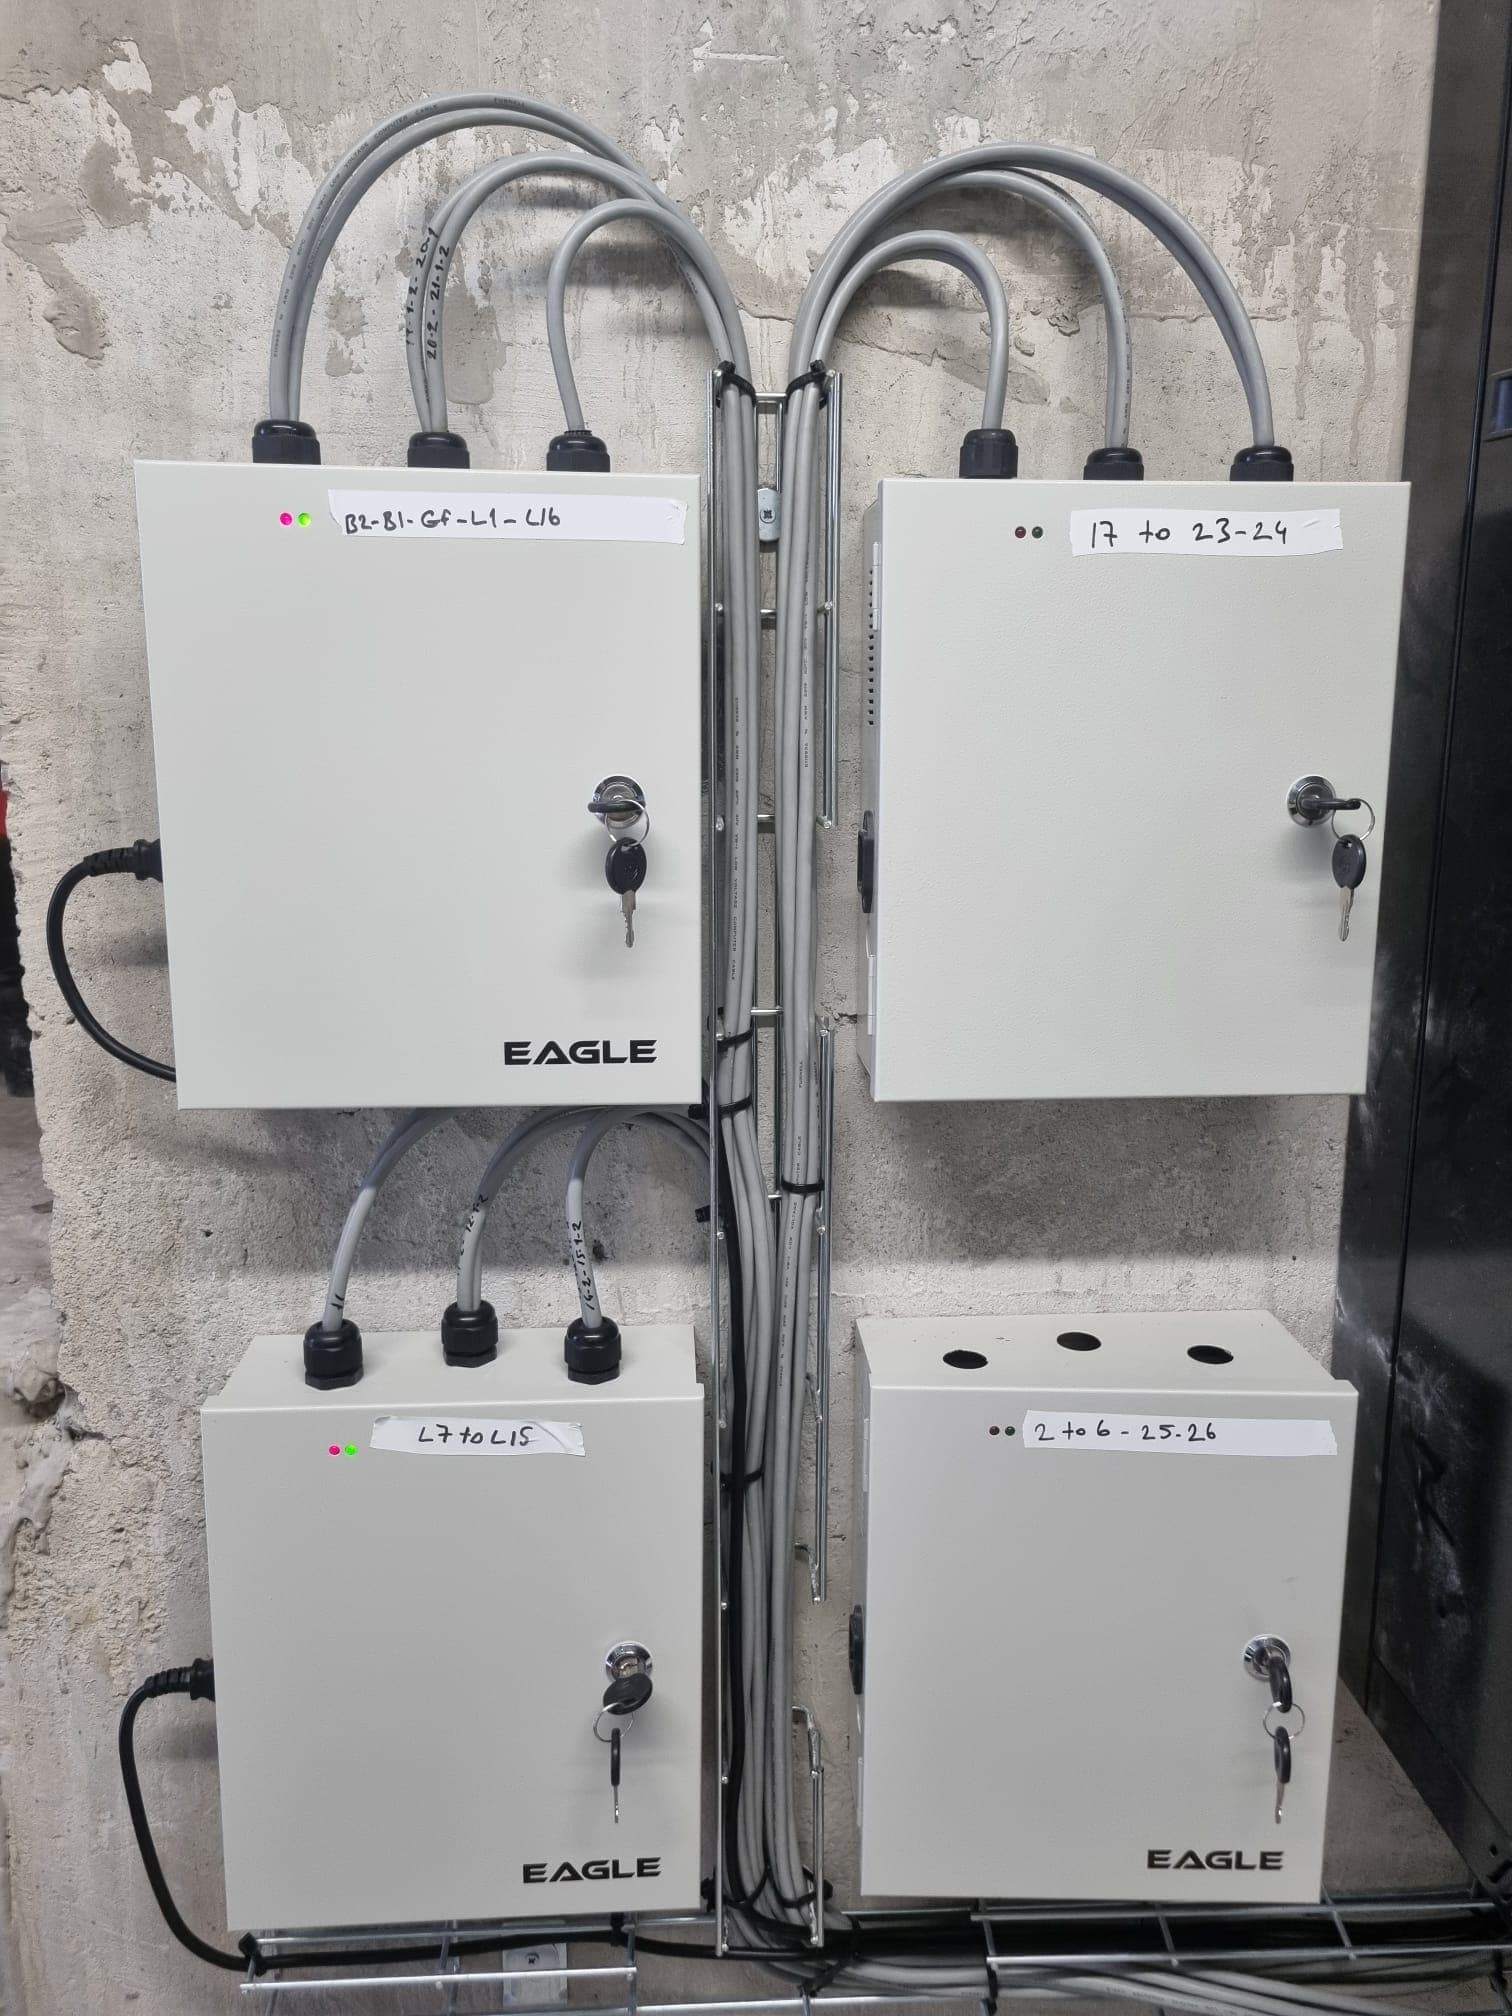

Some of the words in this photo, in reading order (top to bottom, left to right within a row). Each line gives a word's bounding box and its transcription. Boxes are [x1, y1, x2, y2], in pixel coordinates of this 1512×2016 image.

[1091, 520, 1118, 548] 17
[1139, 519, 1171, 544] to
[1192, 517, 1287, 545] 23-24
[504, 1039, 658, 1065] EAGLE
[418, 1424, 453, 1444] L7
[459, 1426, 484, 1444] to
[1034, 1423, 1055, 1441] 2
[1062, 1420, 1087, 1441] to
[523, 1856, 662, 1884] EAGLE
[1147, 1849, 1285, 1871] EAGLE
